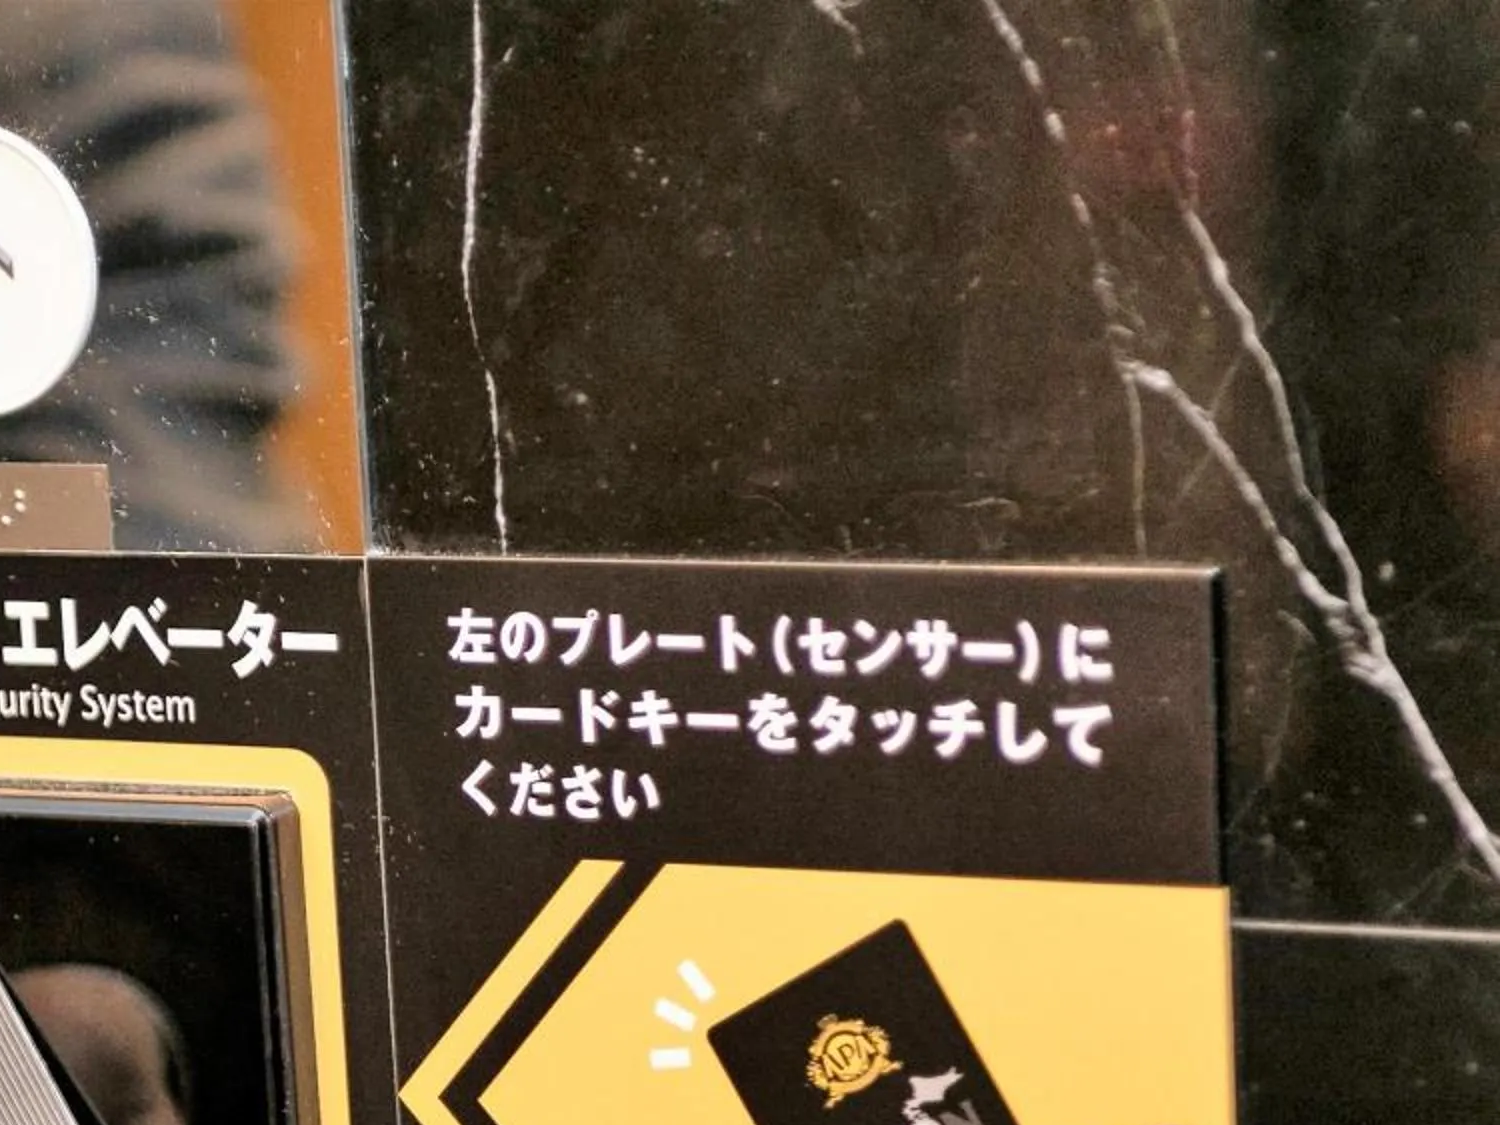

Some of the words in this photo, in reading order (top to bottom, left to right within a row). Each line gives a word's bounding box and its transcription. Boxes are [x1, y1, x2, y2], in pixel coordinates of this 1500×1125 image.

[446, 607, 1114, 684] 左のプレート(センサー)に
[78, 686, 198, 730] System
[453, 684, 1114, 766] カードキーをタッチして
[460, 760, 662, 822] ください
[818, 1031, 879, 1082] APA
